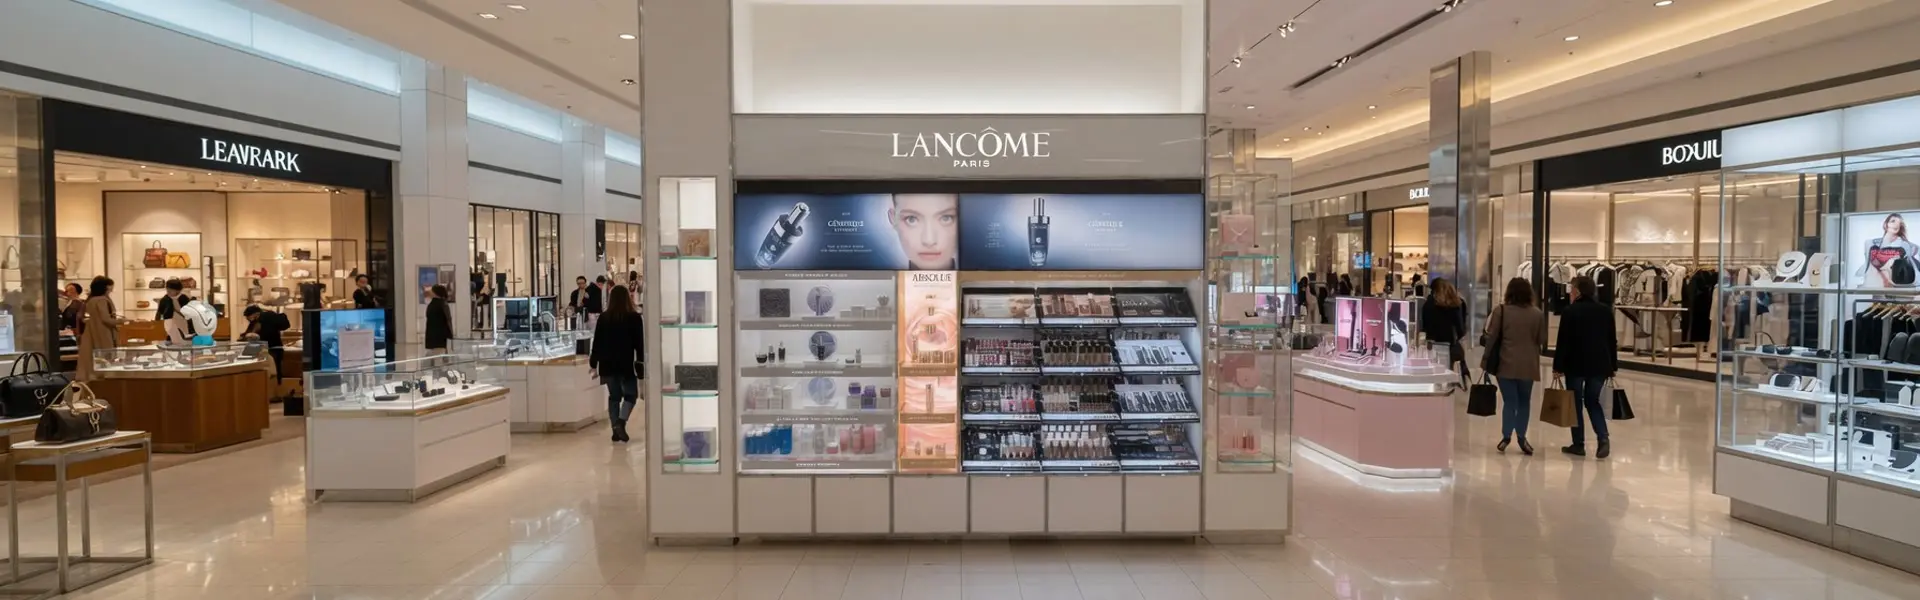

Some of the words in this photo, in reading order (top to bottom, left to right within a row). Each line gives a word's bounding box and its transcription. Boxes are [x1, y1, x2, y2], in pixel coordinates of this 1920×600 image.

[200, 138, 301, 173] LEAVRARK
[891, 126, 1050, 157] LANCÔME
[953, 160, 990, 168] PARIS
